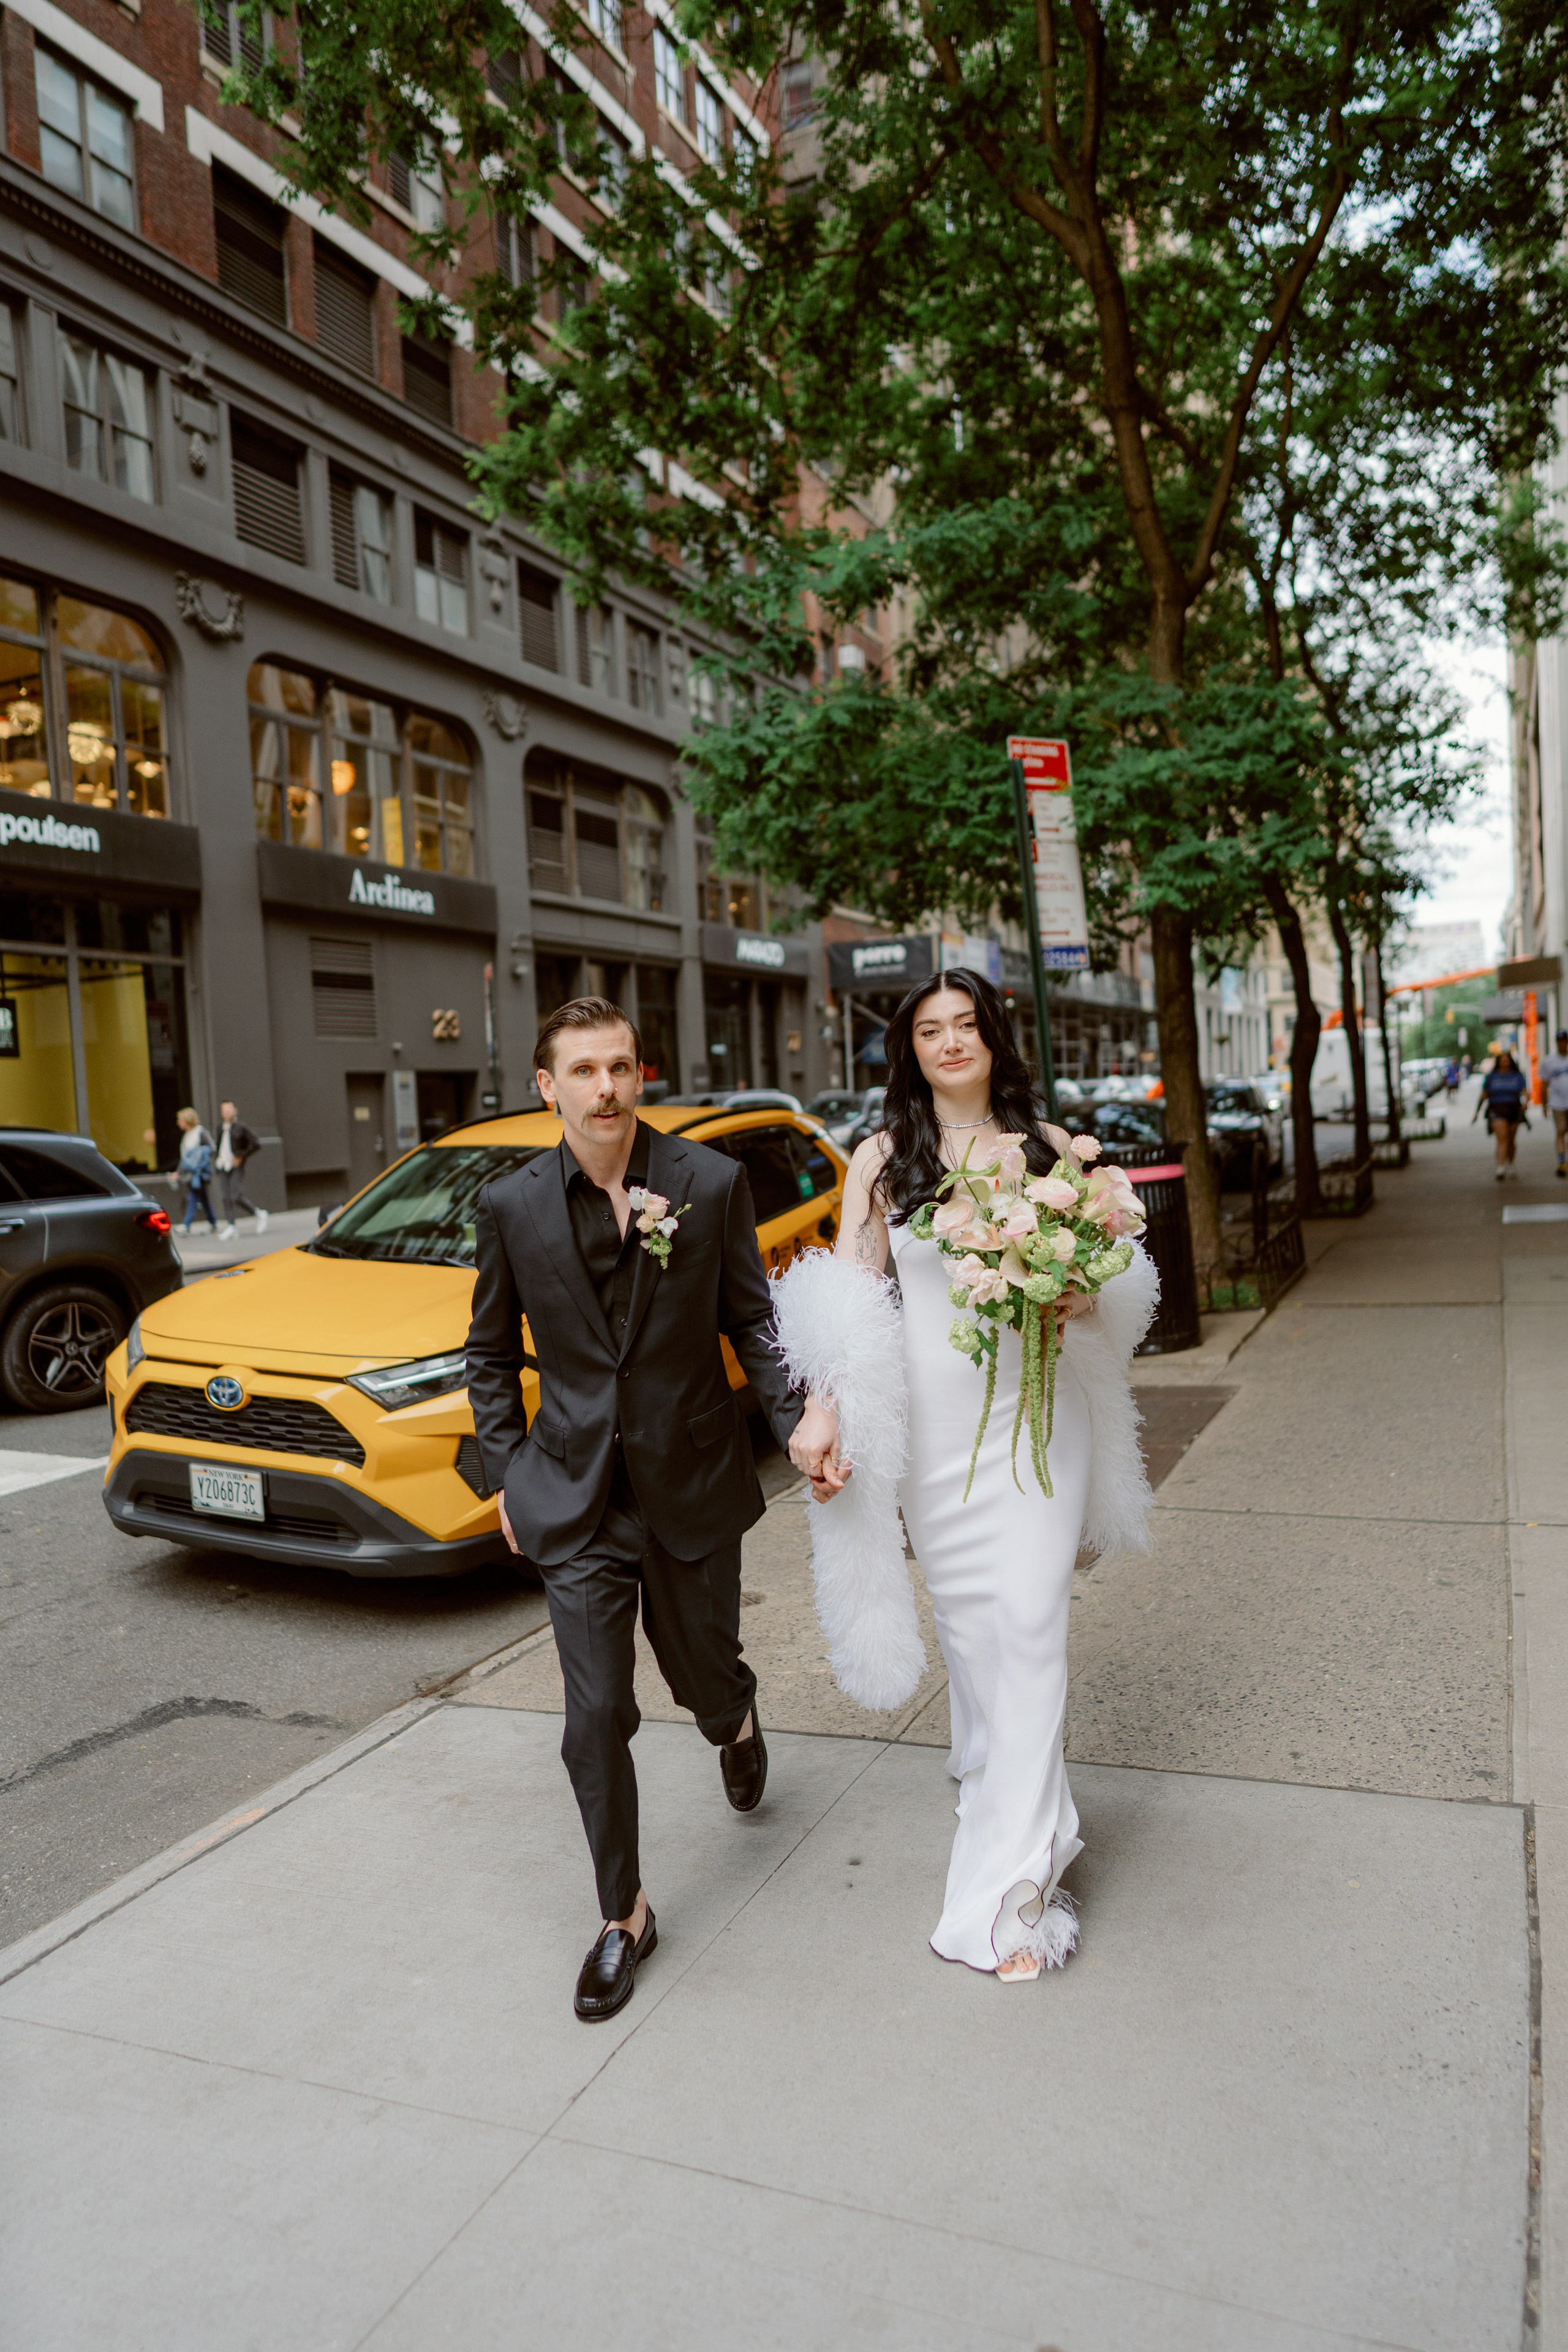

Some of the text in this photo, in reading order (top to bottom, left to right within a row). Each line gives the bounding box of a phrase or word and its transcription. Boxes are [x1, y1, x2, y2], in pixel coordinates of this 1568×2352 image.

[1023, 744, 1059, 758] STANDING
[0, 812, 101, 853] poulsen
[349, 868, 435, 915] Arclinea
[432, 1009, 459, 1039] 23
[209, 1469, 244, 1481] NEW YORK
[197, 1476, 255, 1505] Y206873C
